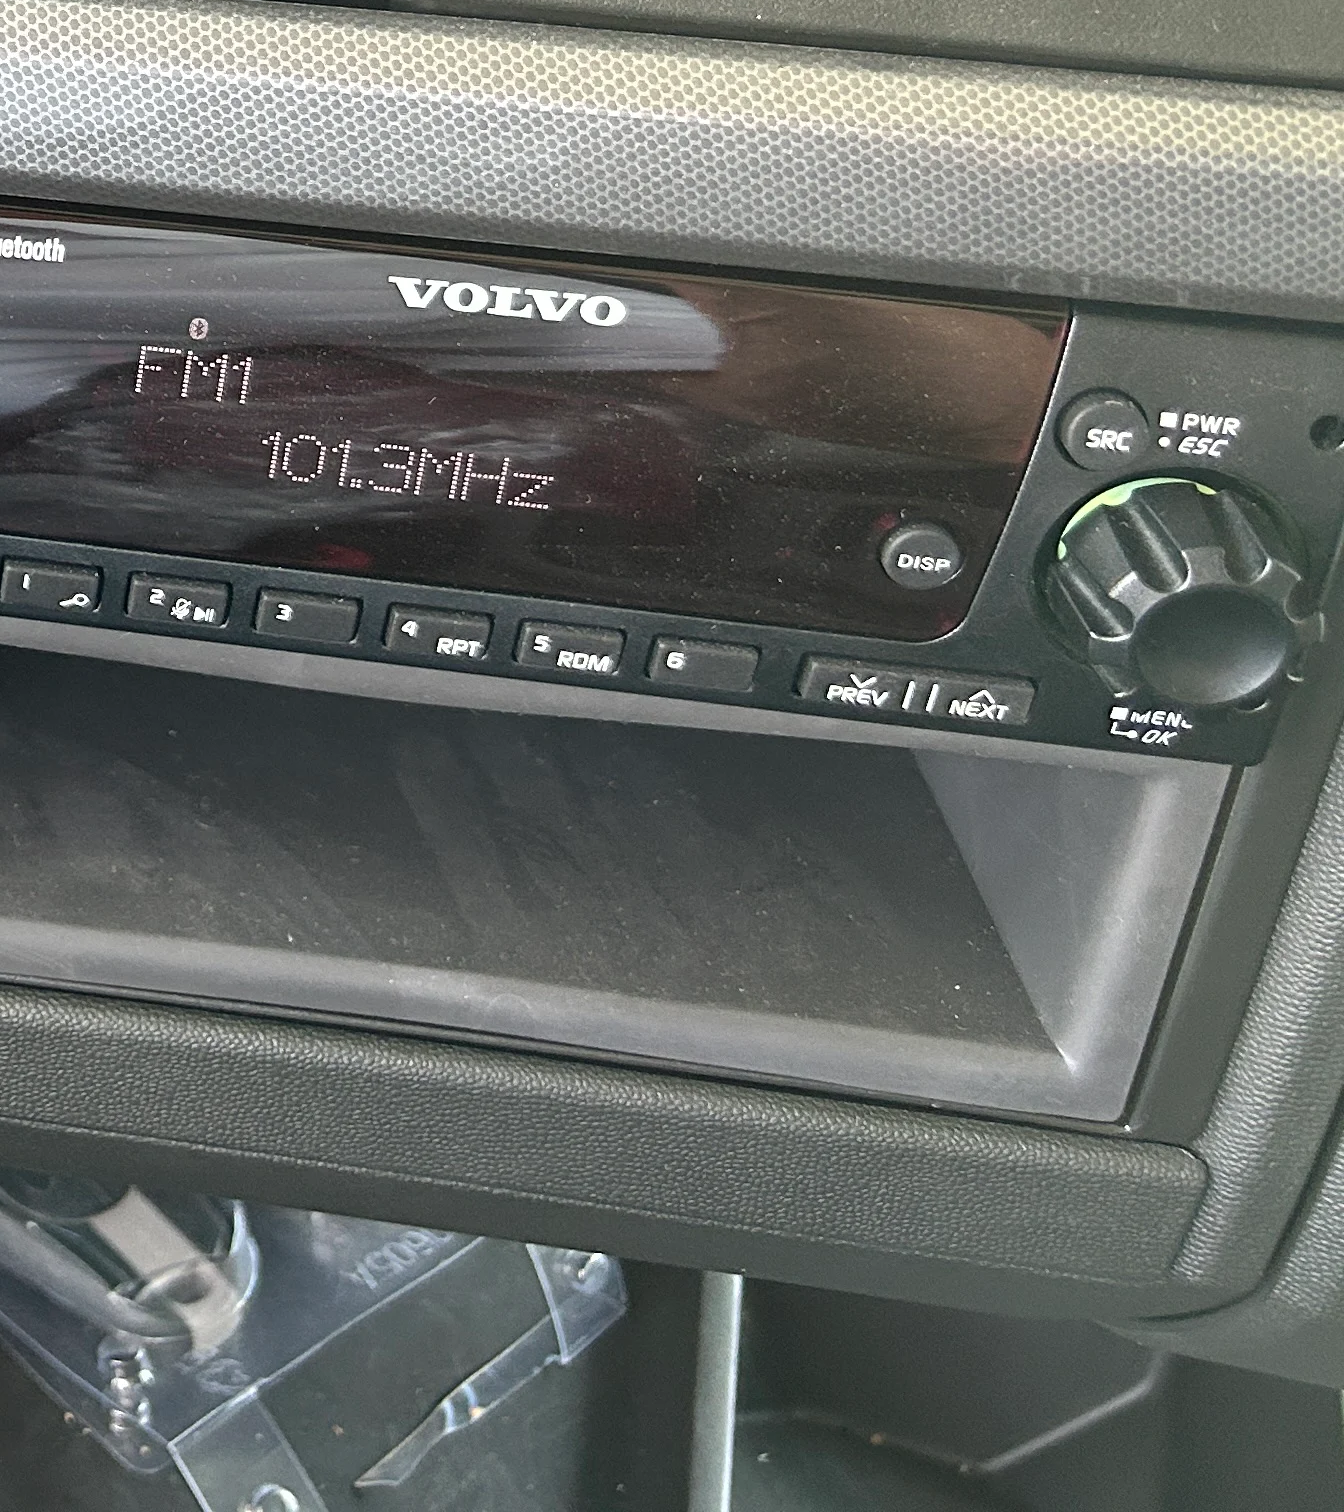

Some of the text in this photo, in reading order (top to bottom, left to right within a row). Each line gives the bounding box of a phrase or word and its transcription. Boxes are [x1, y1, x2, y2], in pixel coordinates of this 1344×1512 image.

[388, 276, 627, 327] VOLVO
[134, 345, 253, 405] FM1
[1182, 413, 1242, 436] PWR
[1085, 428, 1134, 452] SRC
[1178, 436, 1229, 458] ESC
[261, 431, 555, 510] 101.3MHz
[897, 553, 952, 572] DISP
[22, 573, 31, 590] 1
[149, 588, 165, 606] 2
[275, 604, 294, 622] 3
[400, 620, 419, 638] 4
[436, 637, 484, 658] RPT
[532, 635, 552, 653] 5
[556, 649, 612, 673] RDM
[666, 651, 686, 671] 6
[826, 684, 890, 709] PREV
[948, 699, 1011, 722] NEXT
[1141, 730, 1178, 748] OK
